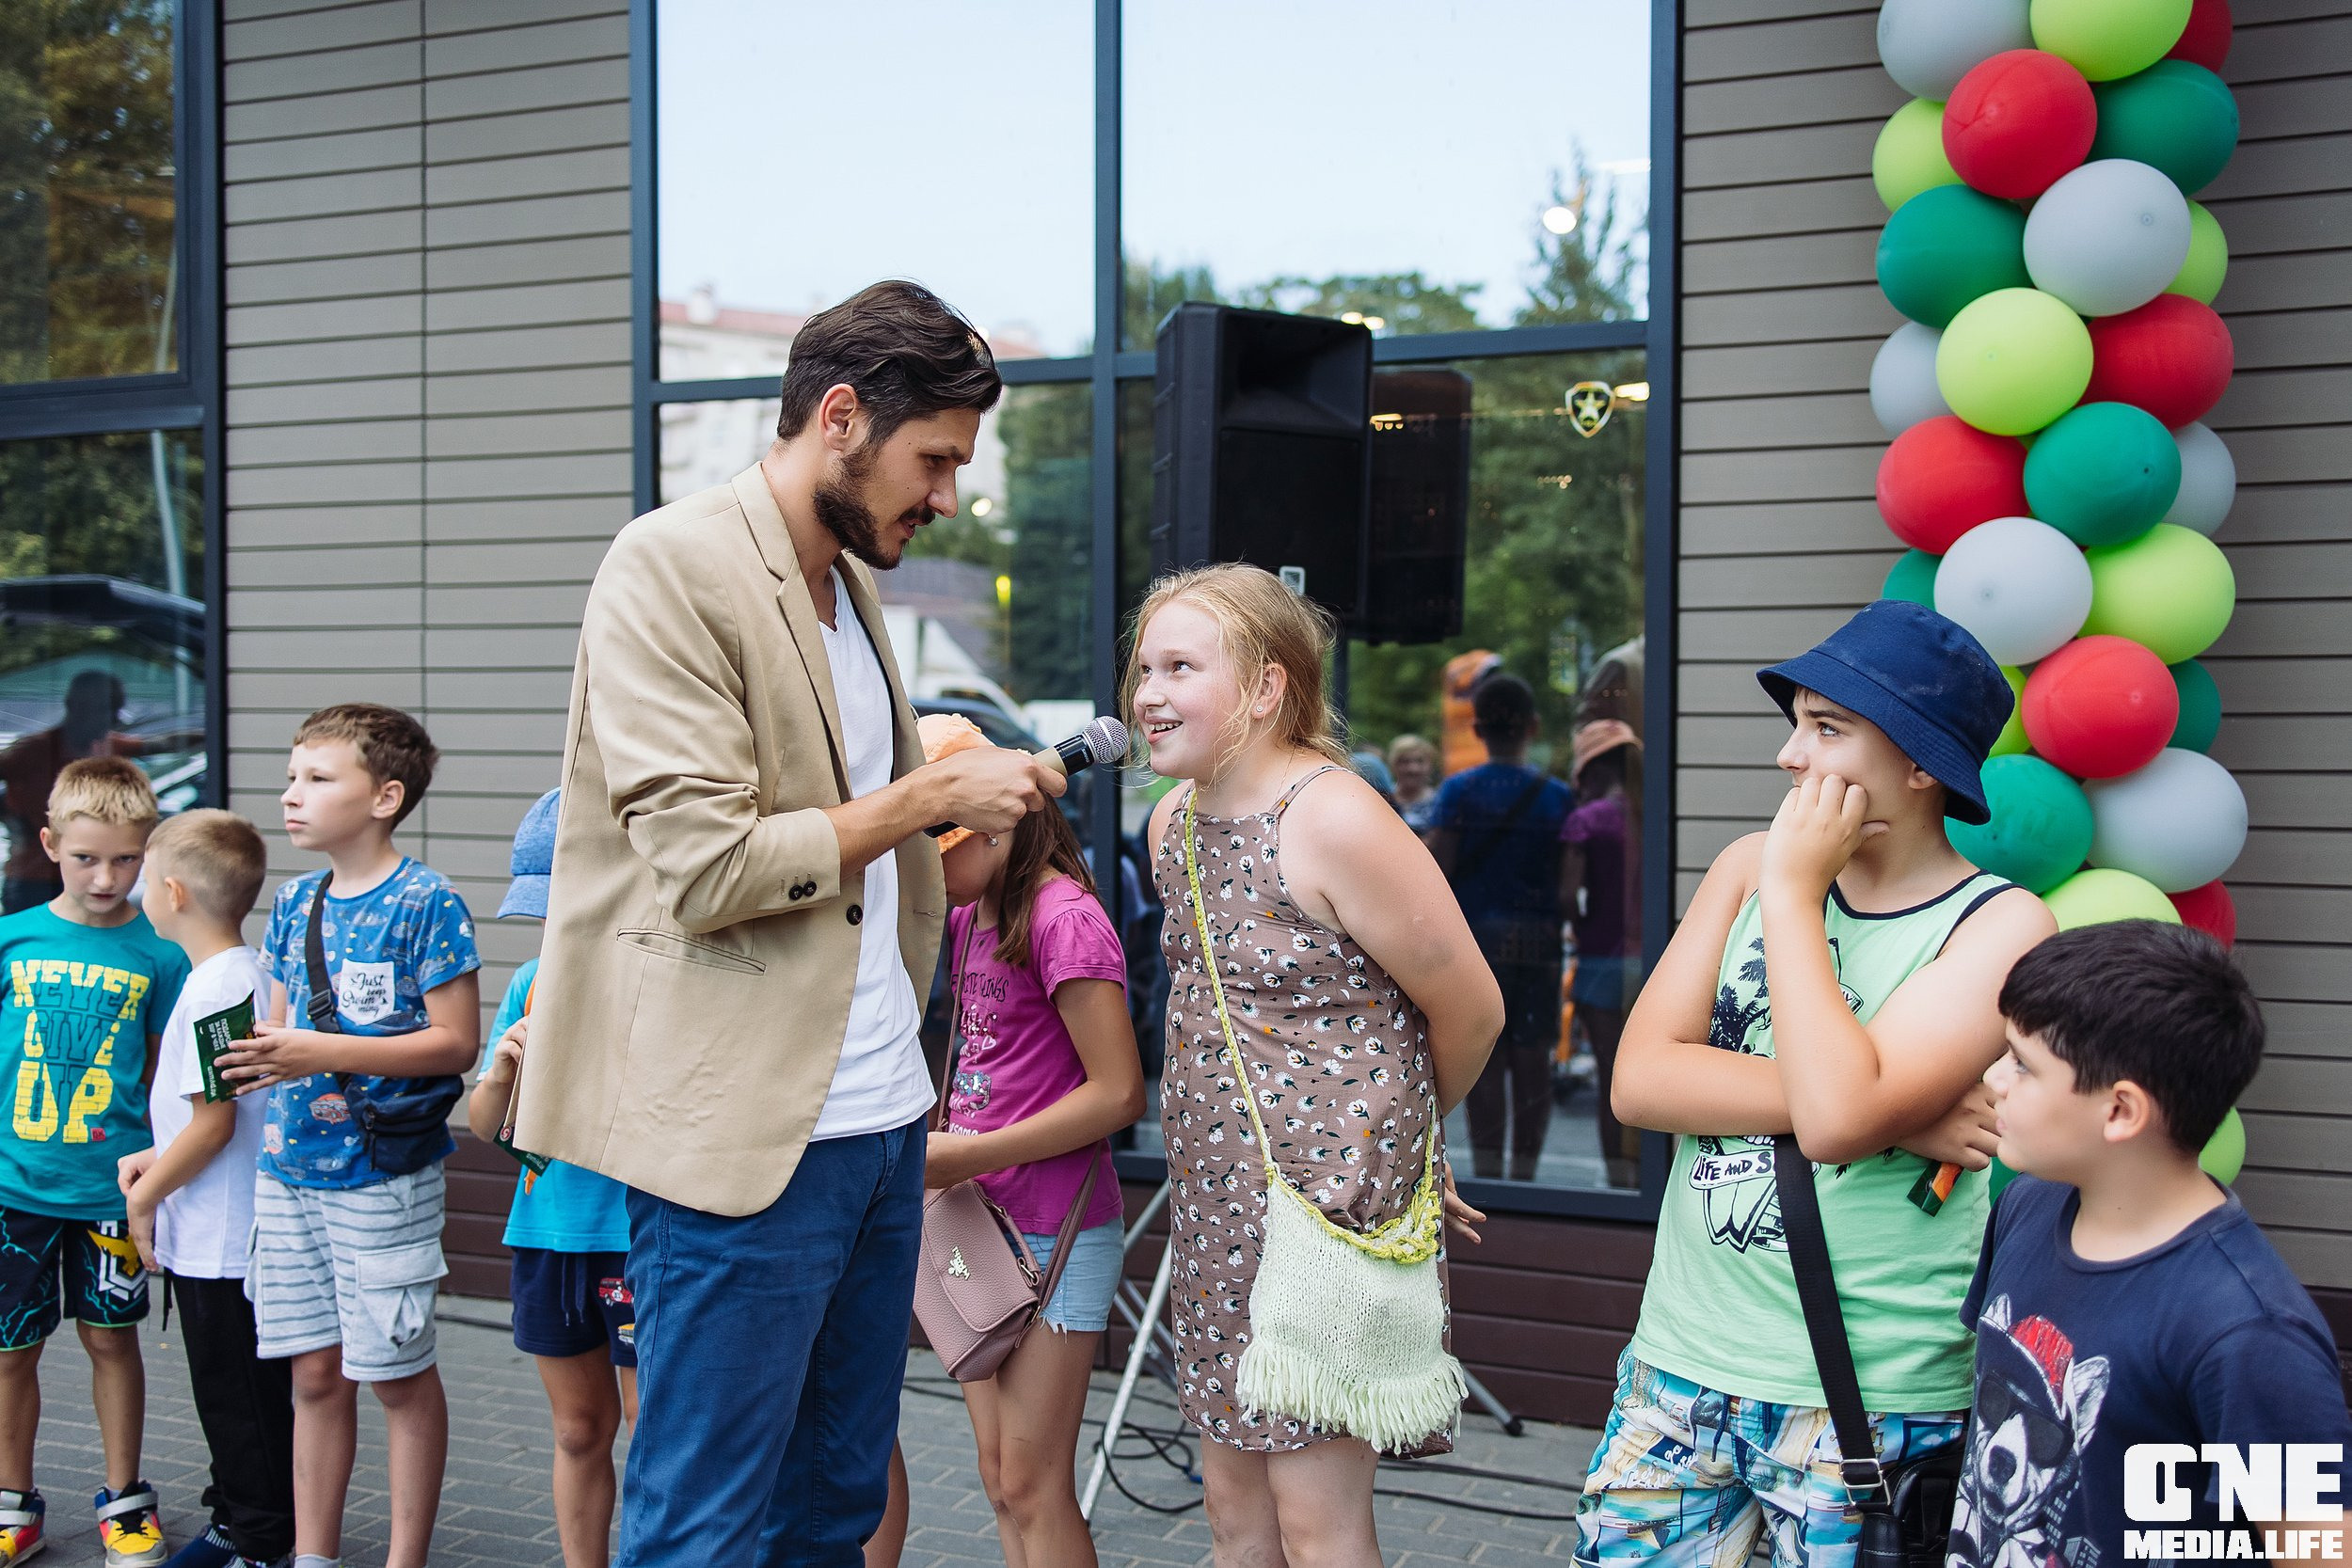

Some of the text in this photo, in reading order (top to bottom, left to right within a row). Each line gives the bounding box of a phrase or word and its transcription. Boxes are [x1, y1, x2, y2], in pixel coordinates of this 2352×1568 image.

[10, 959, 150, 1021] NEVER
[24, 1009, 121, 1076] GIVE
[12, 1060, 114, 1144] UP
[1724, 1159, 1753, 1176] AND
